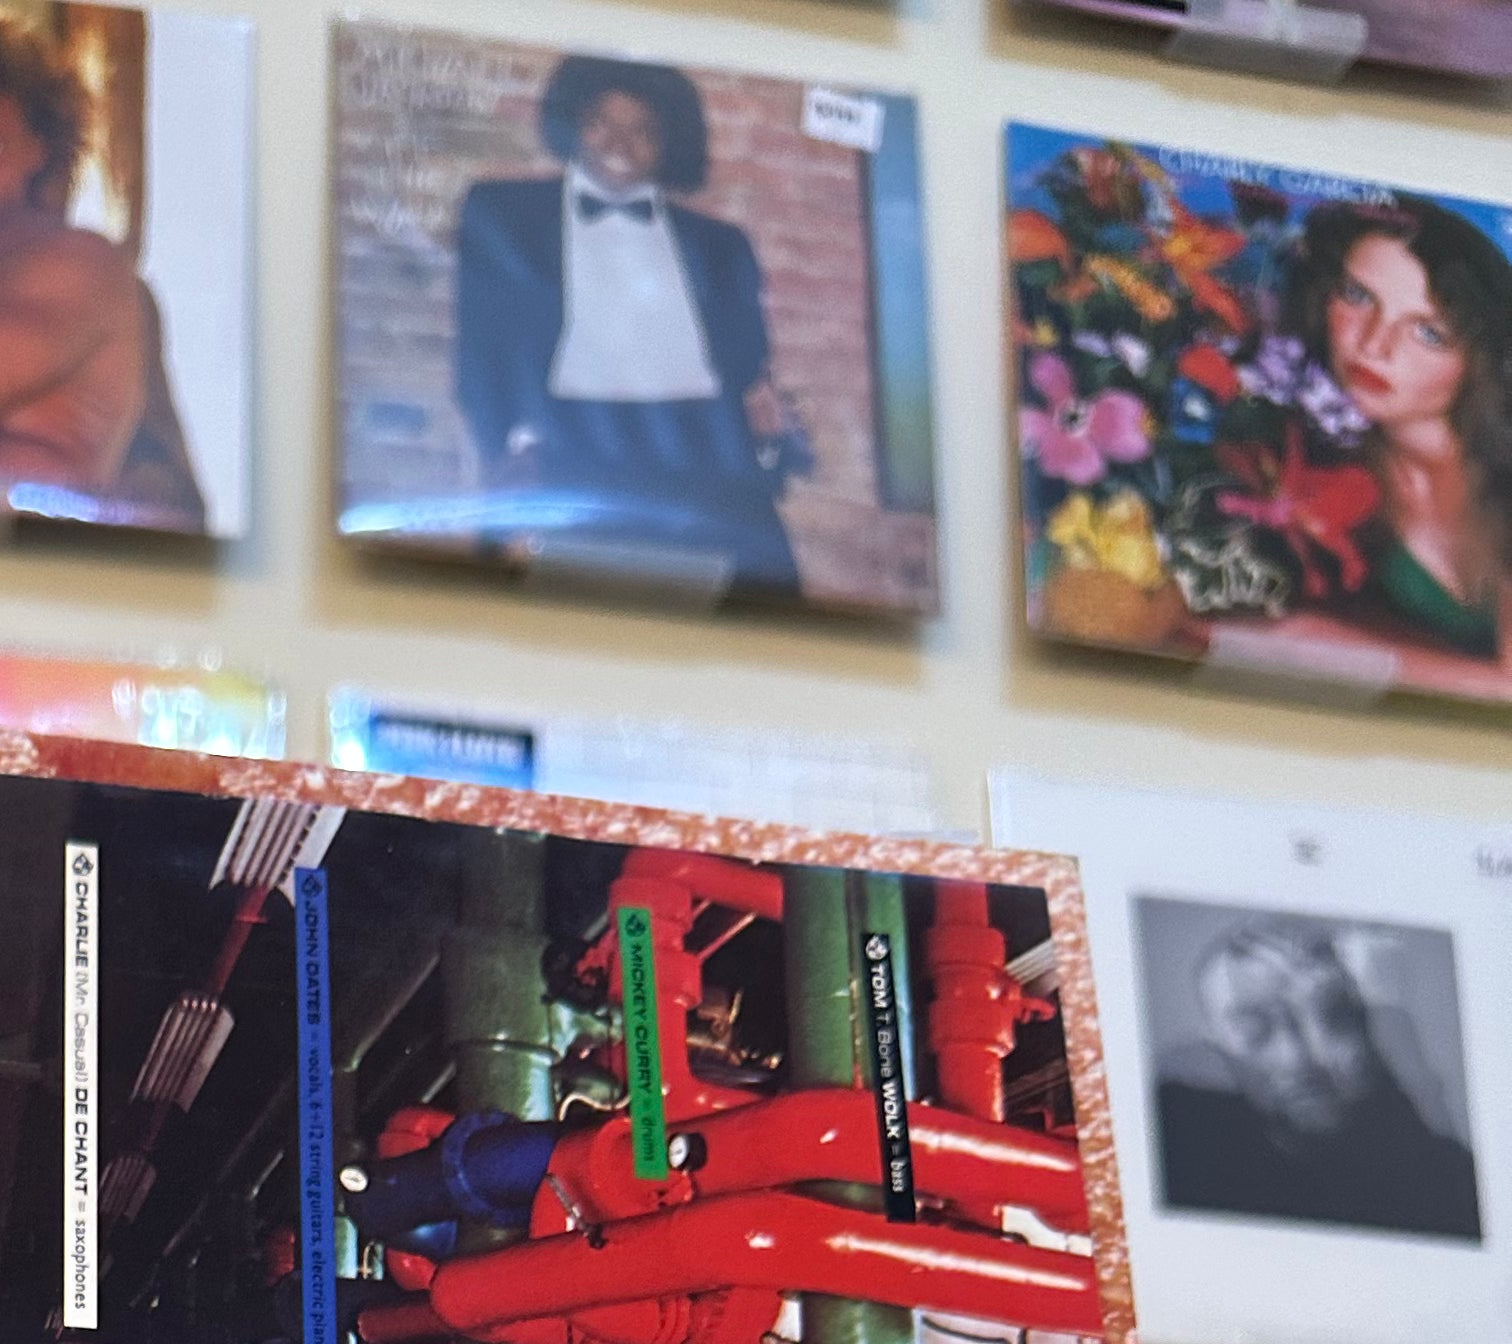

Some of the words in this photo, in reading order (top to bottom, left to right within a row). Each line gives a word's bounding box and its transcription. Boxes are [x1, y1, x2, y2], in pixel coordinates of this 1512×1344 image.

[75, 882, 89, 967] CHARLIE
[304, 901, 321, 957] JOHN
[306, 963, 322, 1026] OATES
[631, 944, 648, 1021] MICKEY
[870, 963, 887, 1008] TOM
[635, 1026, 653, 1094] CURRY
[878, 1030, 893, 1078] Bone
[75, 1088, 88, 1115] DE
[882, 1082, 900, 1139] WOLK
[74, 1121, 88, 1195] CHANT
[306, 1144, 322, 1187] string
[641, 1115, 657, 1161] drums
[890, 1157, 906, 1193] bass
[71, 1219, 90, 1309] saxophones
[309, 1249, 325, 1307] electric
